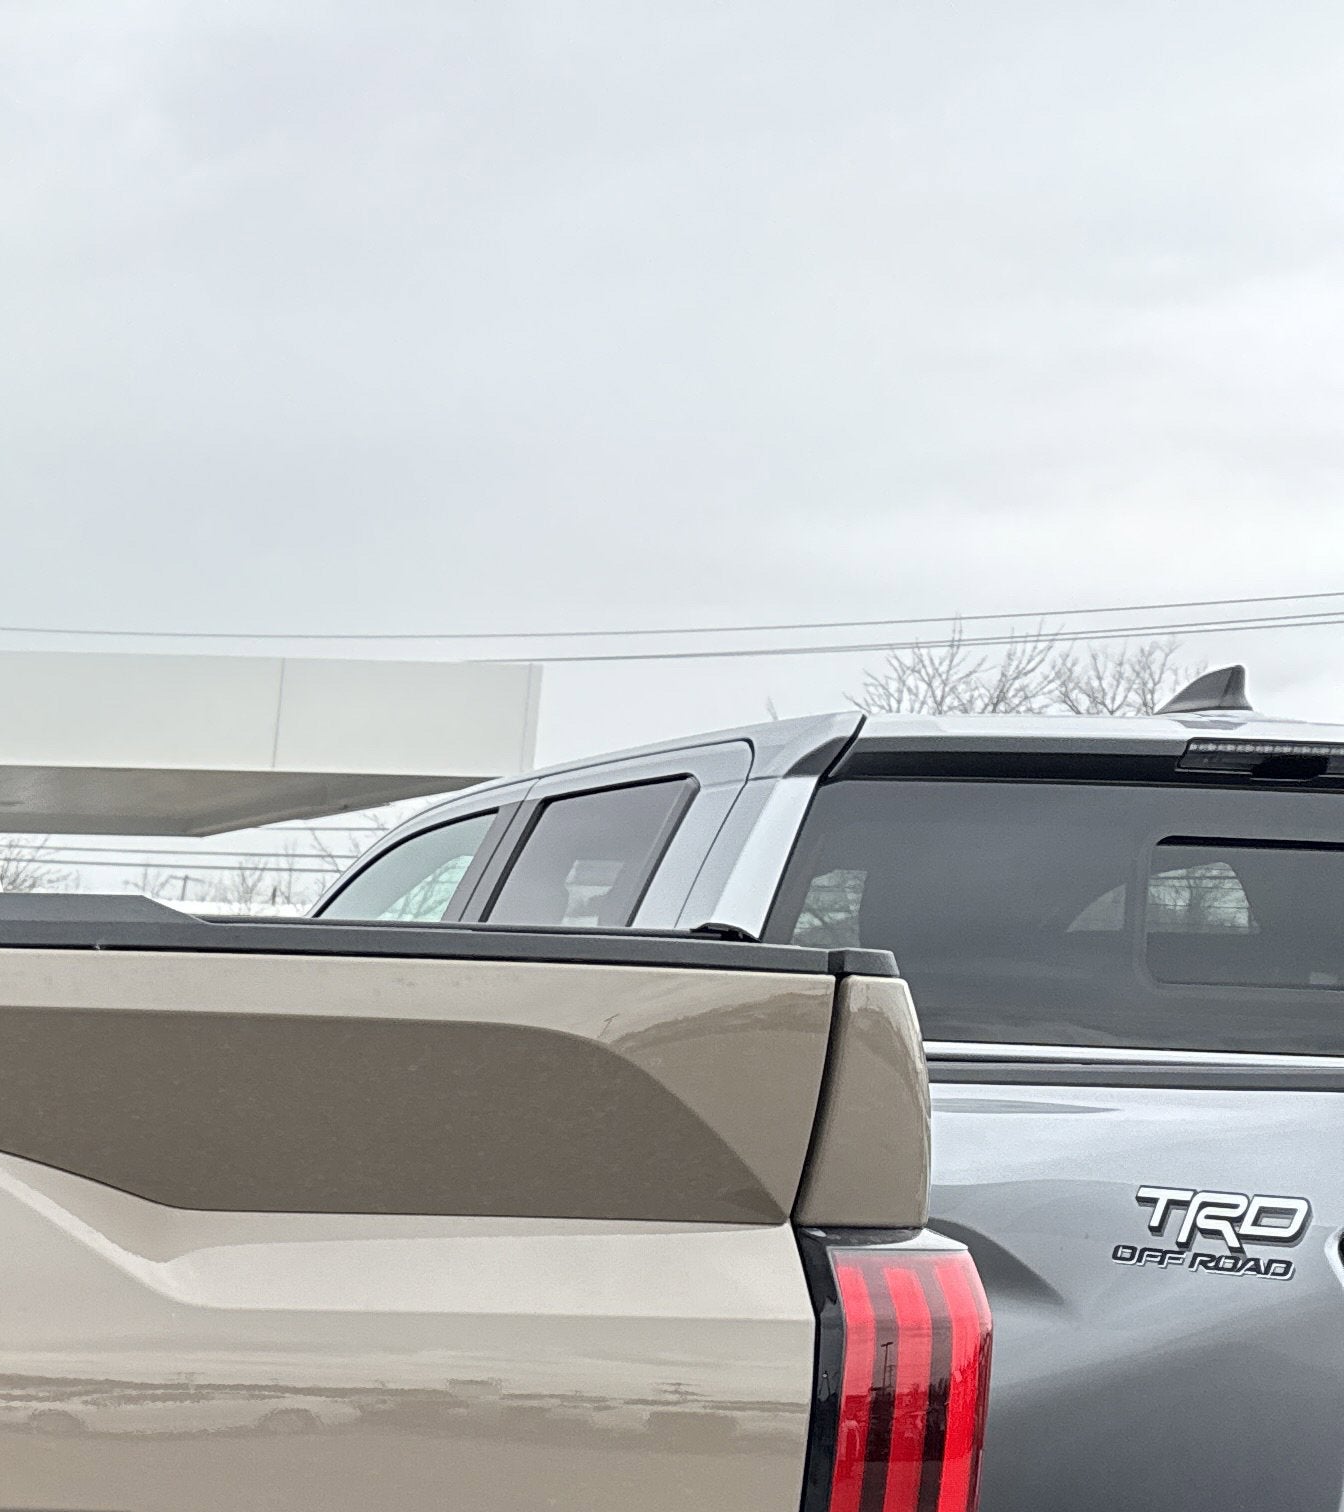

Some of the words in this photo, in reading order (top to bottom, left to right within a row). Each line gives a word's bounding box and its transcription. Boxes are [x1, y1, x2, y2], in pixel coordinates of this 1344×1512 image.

[1135, 1184, 1312, 1254] TRD
[1112, 1244, 1187, 1269] OFF
[1188, 1252, 1296, 1281] ROAD
